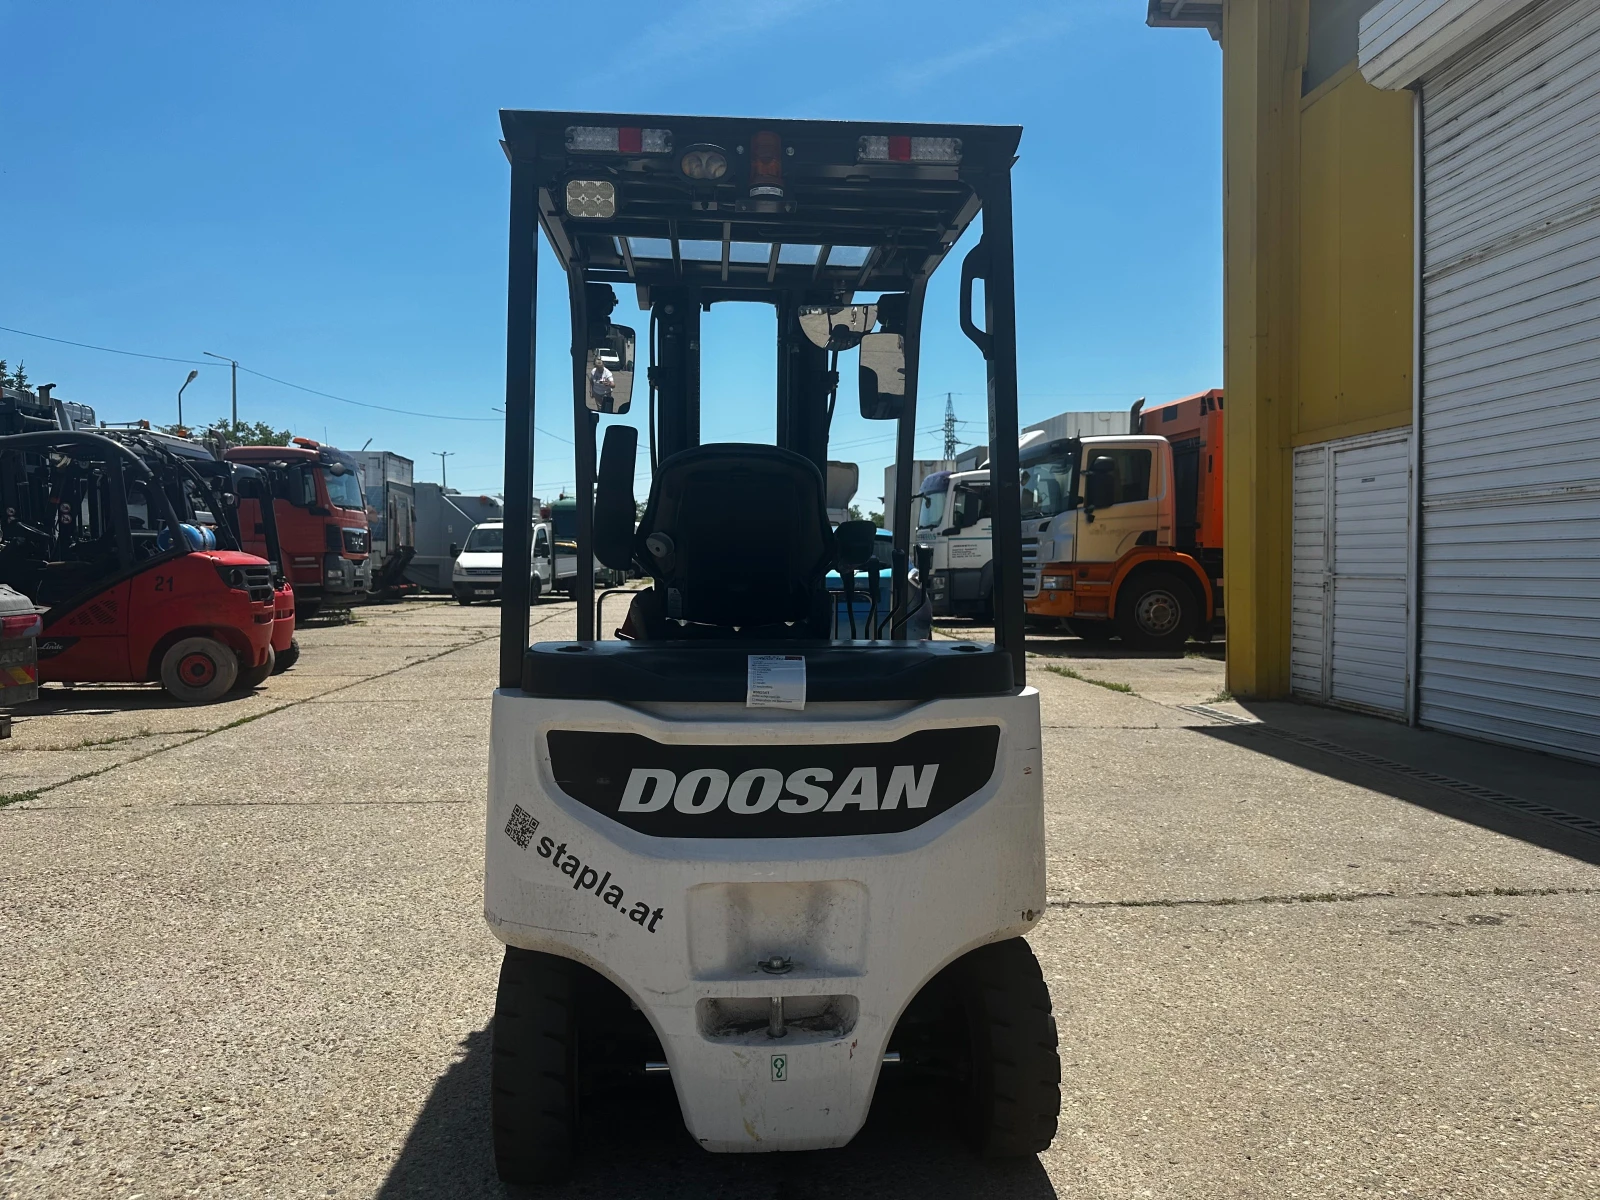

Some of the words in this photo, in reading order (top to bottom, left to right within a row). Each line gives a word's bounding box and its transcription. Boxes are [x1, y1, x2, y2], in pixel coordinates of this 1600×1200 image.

[154, 576, 173, 592] 21
[38, 641, 64, 650] Linde
[618, 763, 939, 815] DOOSAN
[536, 832, 665, 935] stapla.at
